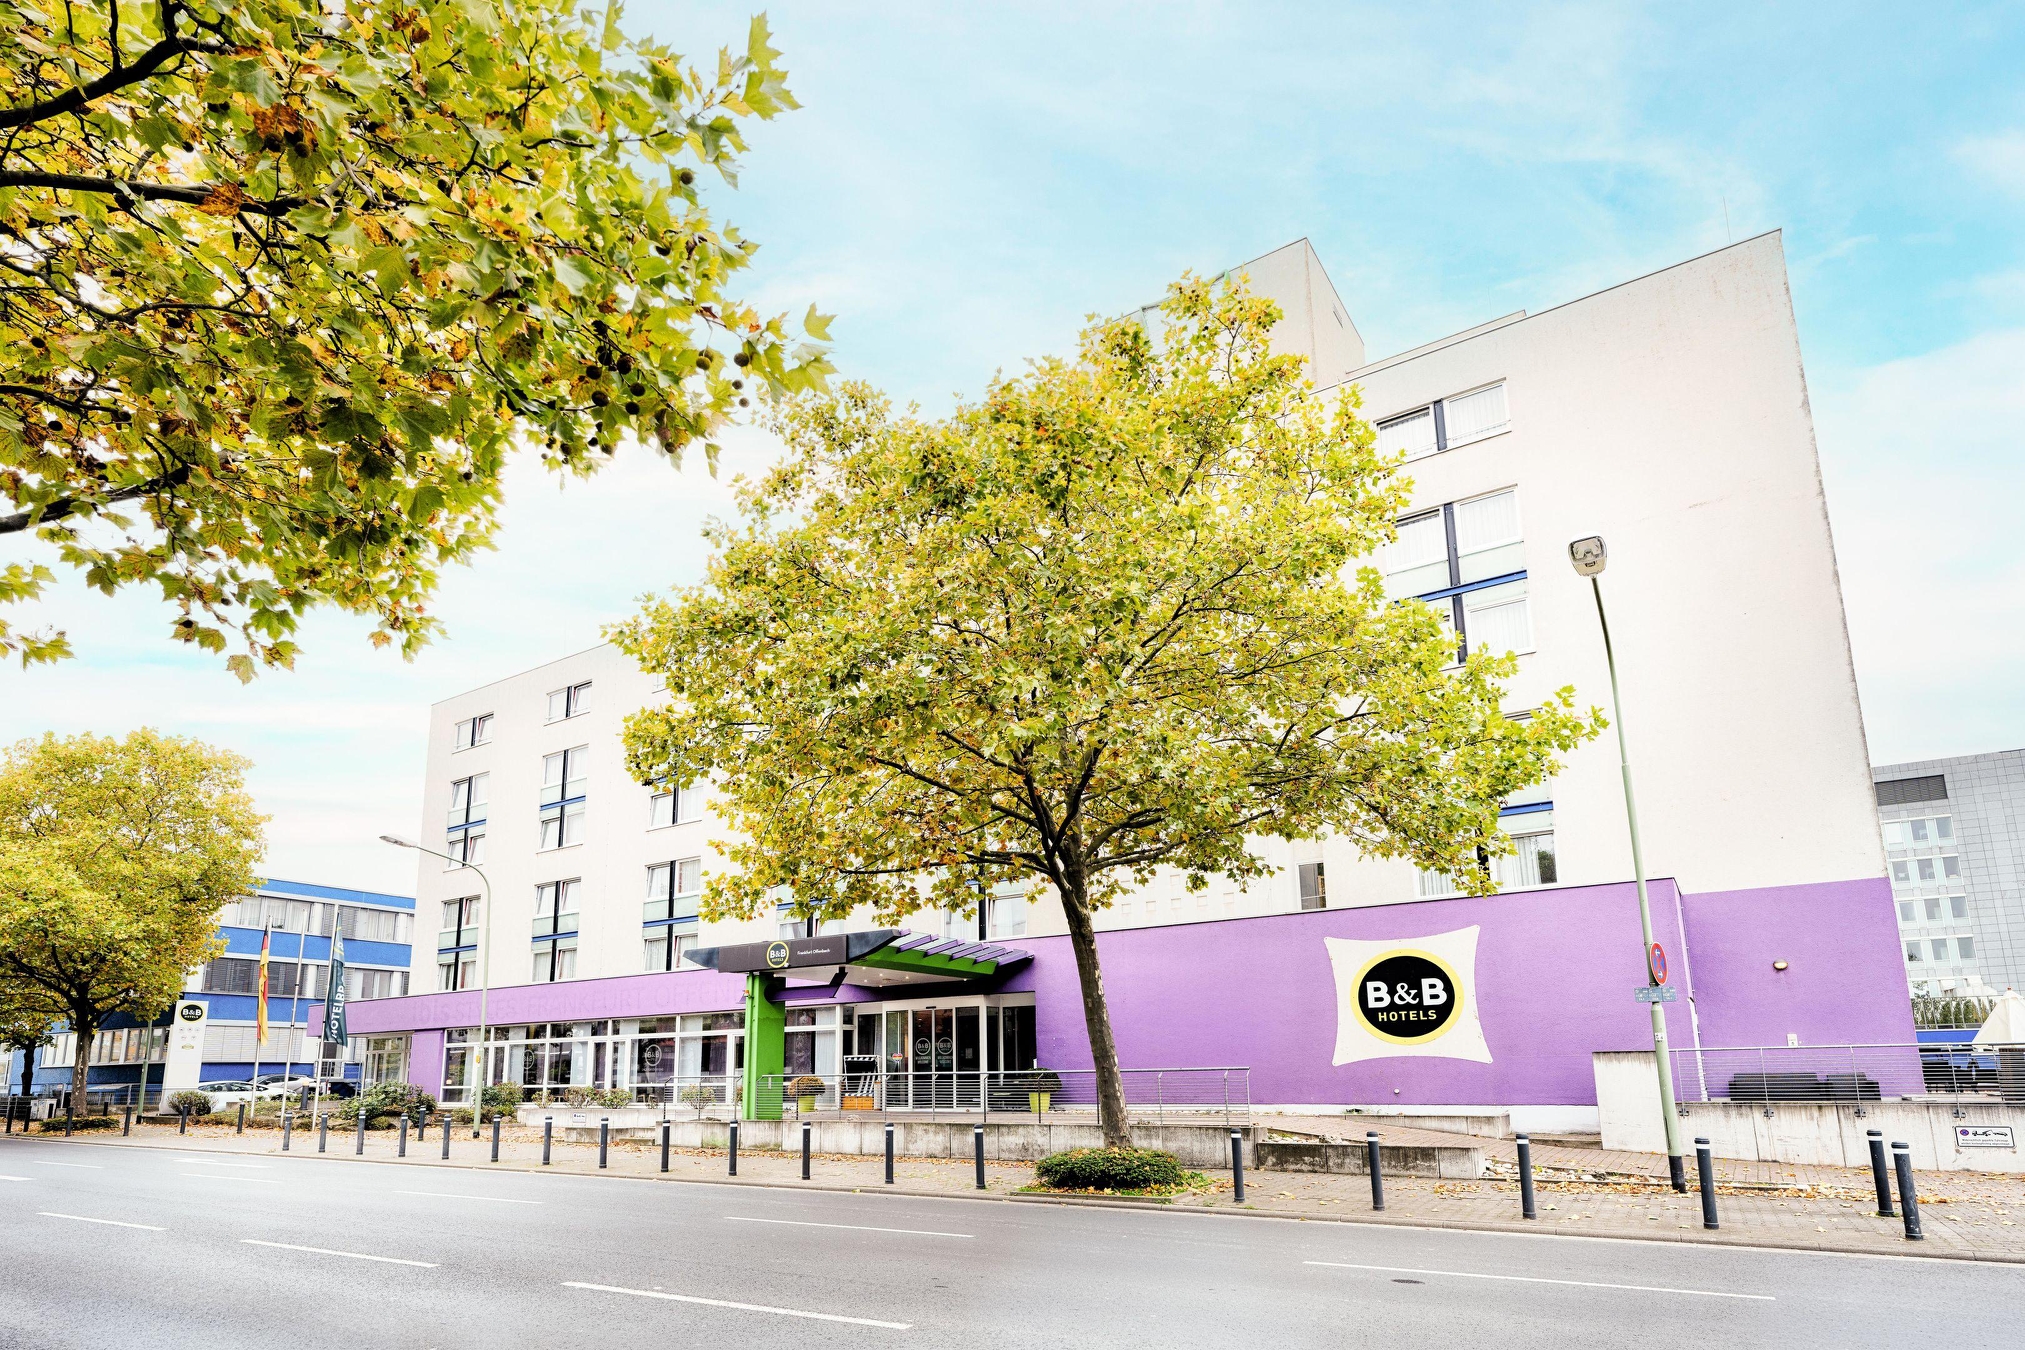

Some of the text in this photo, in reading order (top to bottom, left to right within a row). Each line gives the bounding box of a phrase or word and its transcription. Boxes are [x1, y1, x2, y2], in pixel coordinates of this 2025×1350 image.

[770, 949, 786, 959] B&B
[1366, 978, 1447, 1008] B&B
[182, 1008, 202, 1016] B&B
[1378, 1010, 1437, 1022] HOTELS
